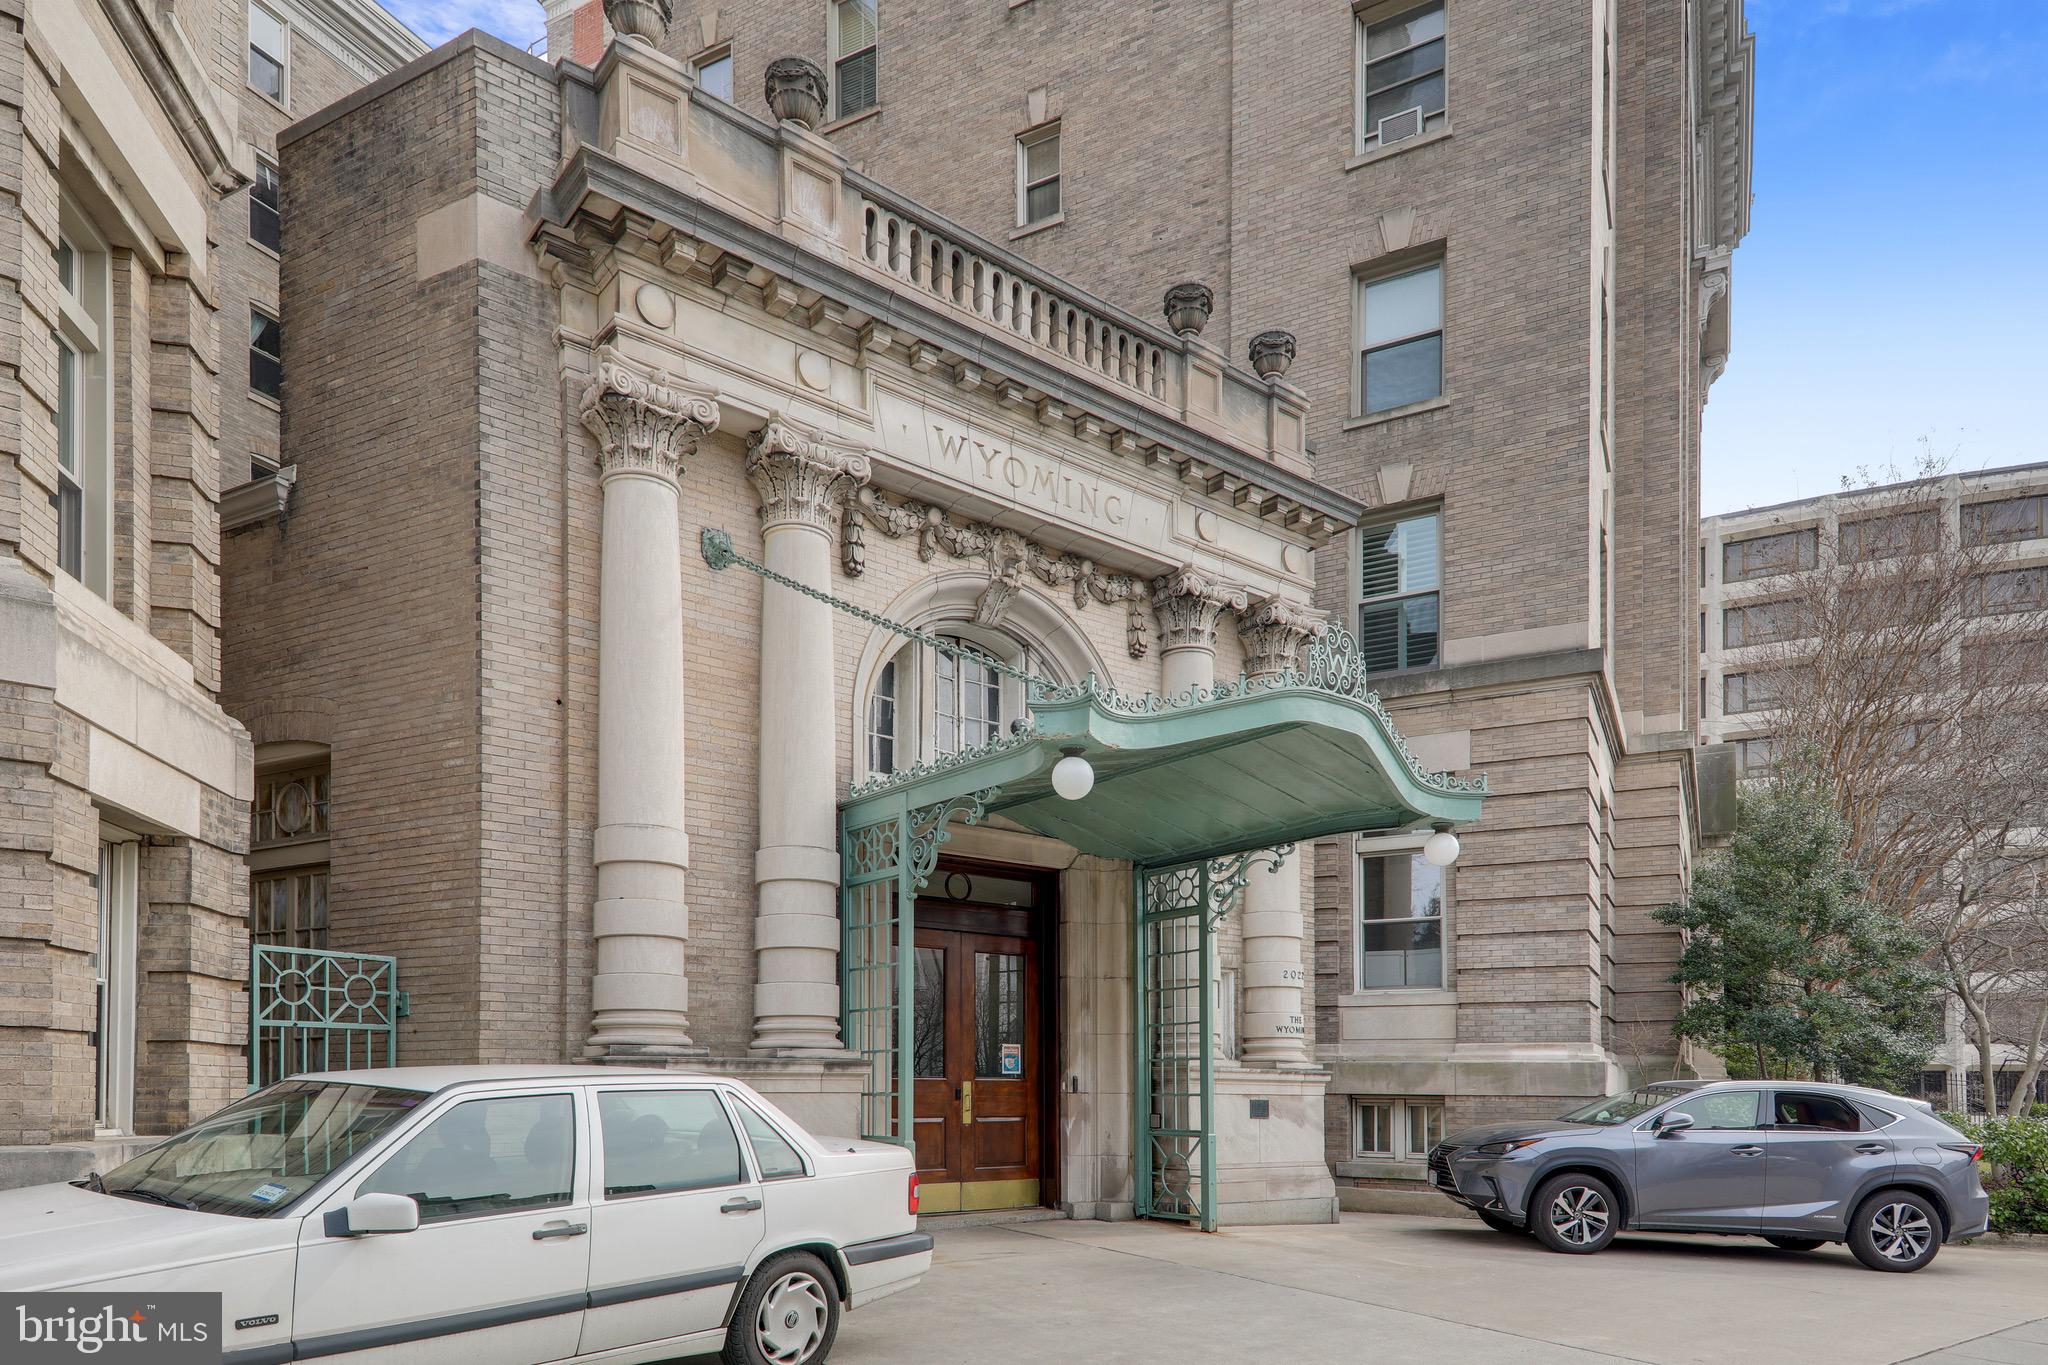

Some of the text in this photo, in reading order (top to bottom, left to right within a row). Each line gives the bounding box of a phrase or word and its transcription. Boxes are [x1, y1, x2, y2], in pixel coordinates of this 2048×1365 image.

[932, 424, 1126, 525] WYOMING
[1289, 1015, 1302, 1024] THE
[240, 1316, 276, 1327] VOLVO
